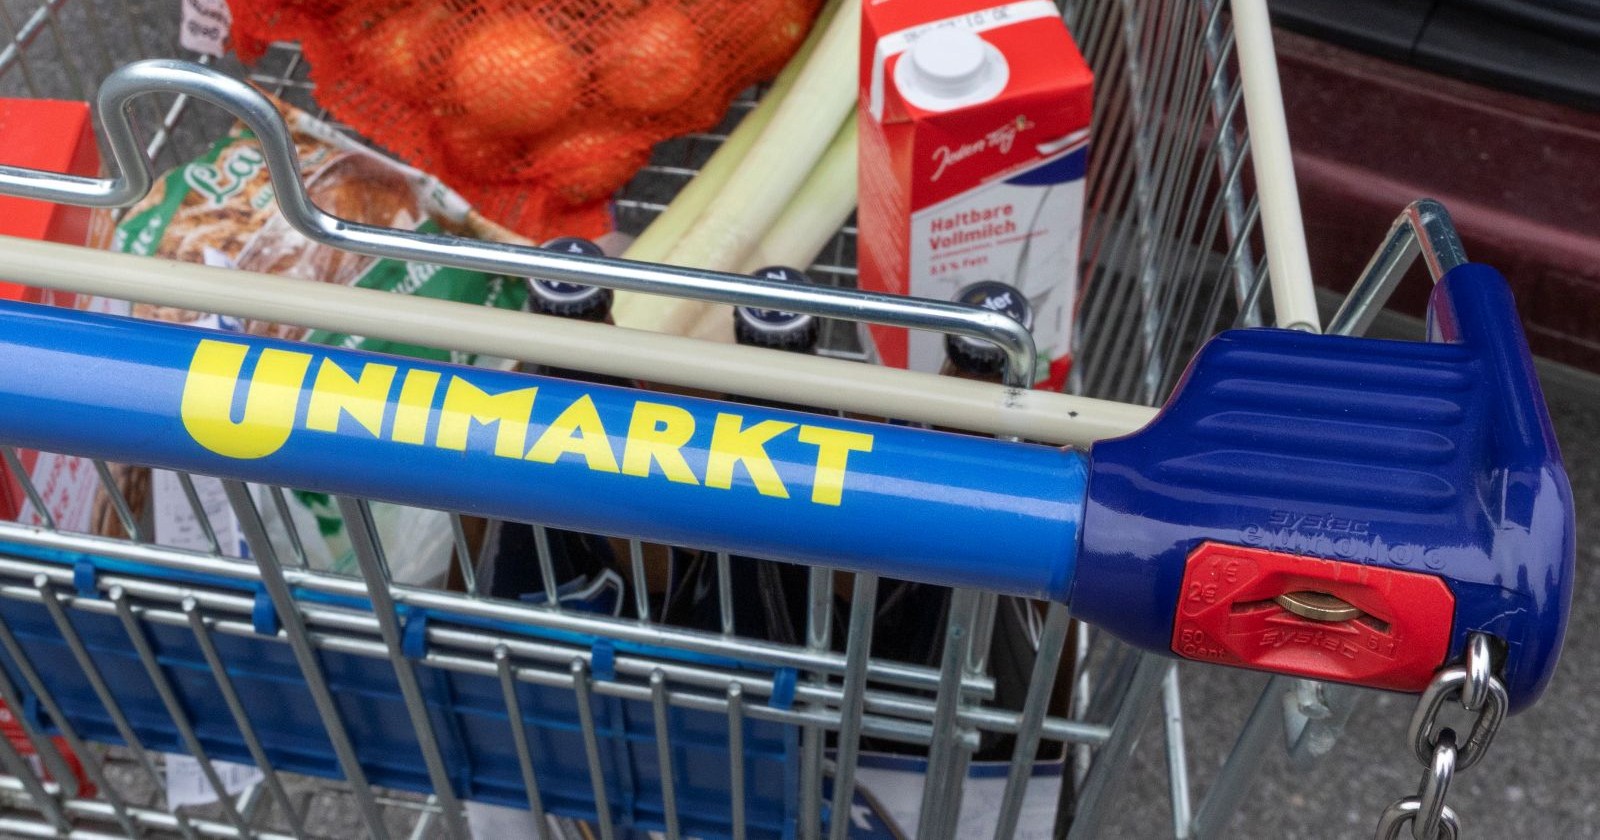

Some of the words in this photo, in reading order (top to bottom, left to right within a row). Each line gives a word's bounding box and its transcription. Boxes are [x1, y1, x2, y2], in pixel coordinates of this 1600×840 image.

[184, 144, 268, 208] La
[930, 203, 1014, 234] Haltbare
[929, 219, 1017, 251] Vollmilch
[181, 338, 874, 507] UNIMARKT
[1269, 508, 1371, 536] systec
[1258, 628, 1360, 659] systec
